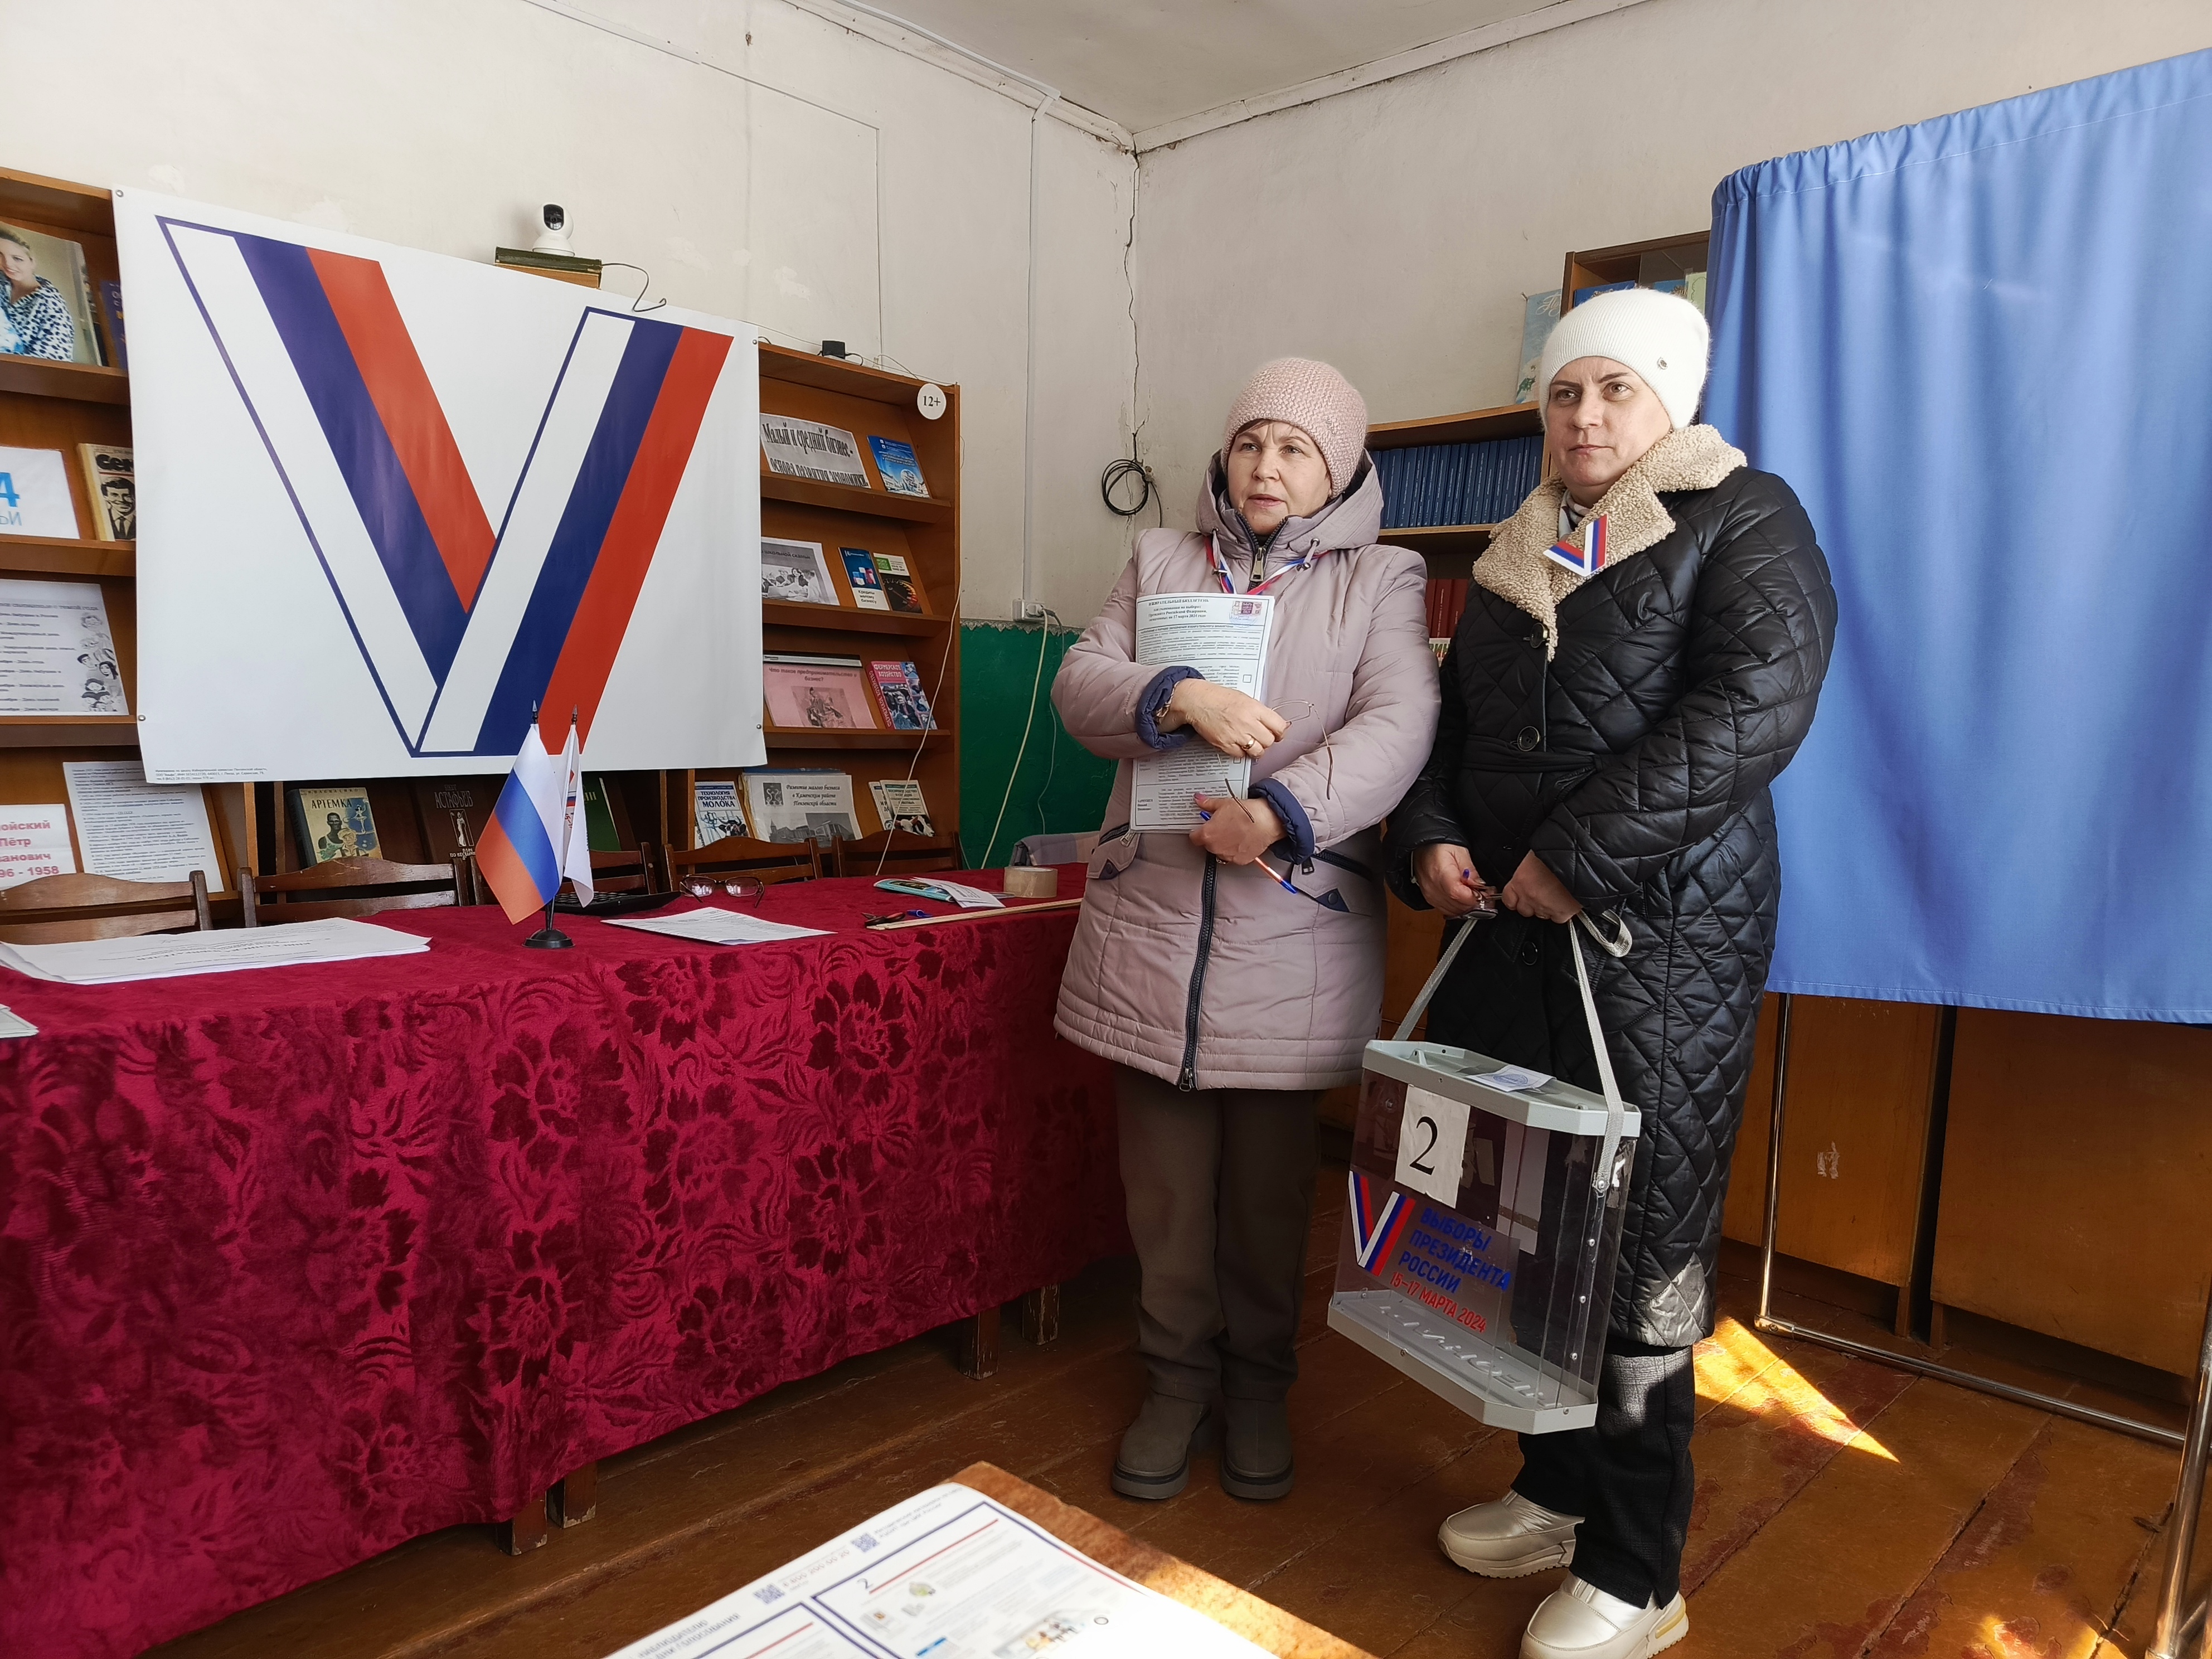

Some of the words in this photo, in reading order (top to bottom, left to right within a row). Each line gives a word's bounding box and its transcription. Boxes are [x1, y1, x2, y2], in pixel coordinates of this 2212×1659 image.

[923, 395, 941, 407] 12+
[763, 422, 791, 445] Малый
[790, 429, 797, 446] и
[797, 426, 827, 454] средний
[825, 429, 851, 457] бизнес
[770, 458, 796, 475] основа
[795, 464, 830, 482] развития
[312, 798, 352, 809] АРТЕМКА
[434, 791, 473, 808] АСТАФЬЕВ
[0, 820, 51, 831] ойский
[27, 866, 60, 876] 1958
[1409, 1116, 1438, 1175] 2
[1420, 1207, 1492, 1251] ВЫБОРЫ
[1399, 1250, 1462, 1293] РОССИИ
[1409, 1229, 1511, 1292] ПРЕЗИДЕНТА
[1419, 1286, 1458, 1318] МАРТА
[1457, 1307, 1487, 1333] 2024
[857, 1578, 873, 1589] 2
